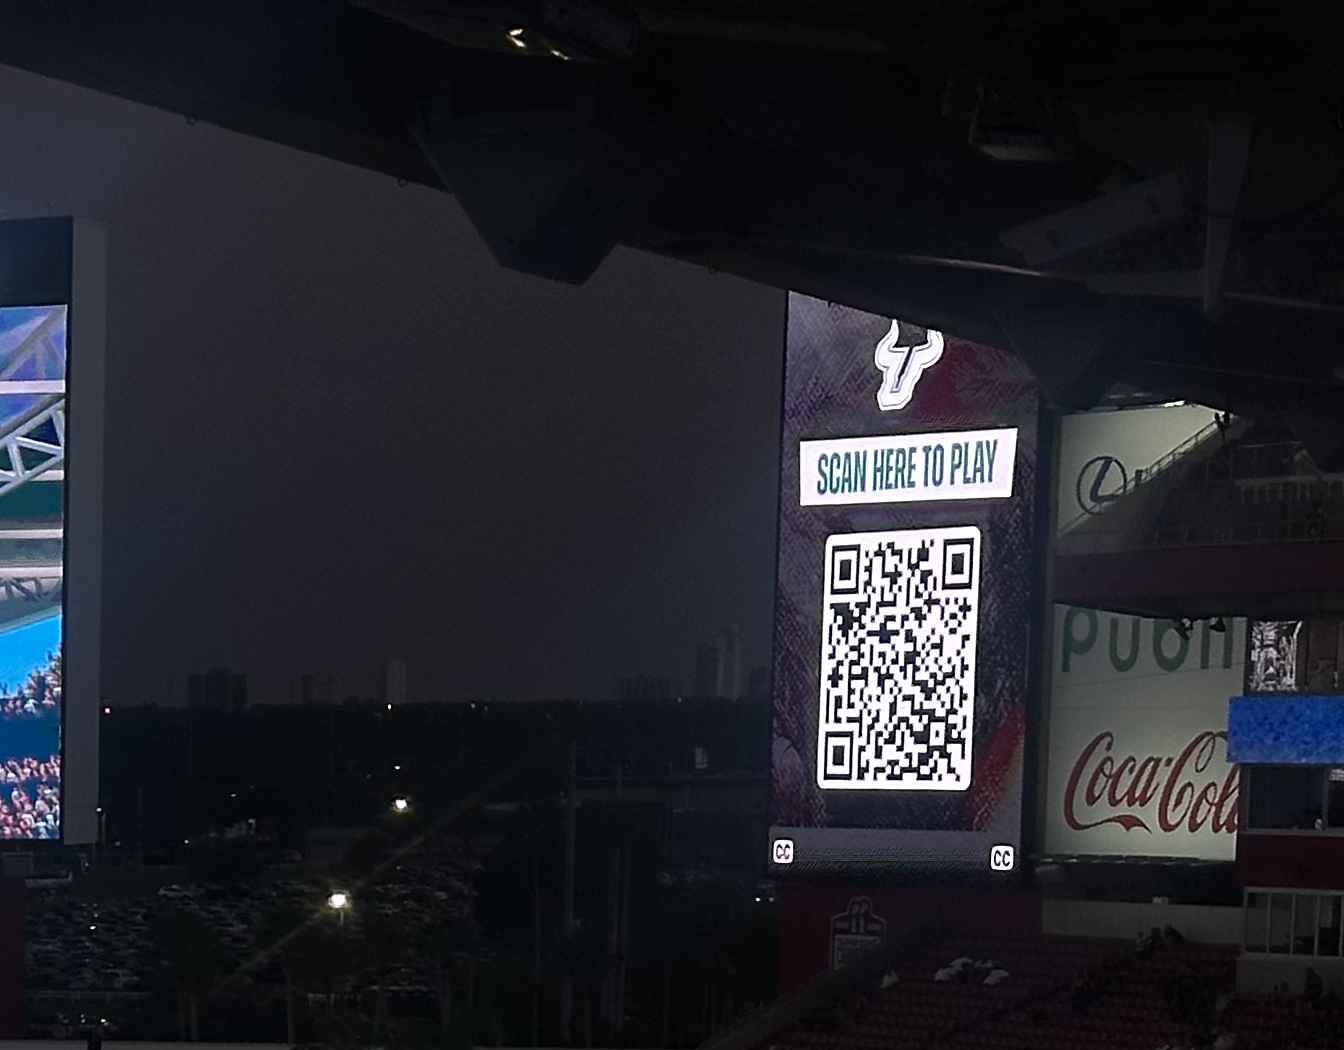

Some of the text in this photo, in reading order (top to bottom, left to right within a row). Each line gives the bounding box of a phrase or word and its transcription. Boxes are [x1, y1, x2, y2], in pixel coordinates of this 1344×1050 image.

[817, 439, 999, 496] SCAN HERE TO PLAY
[993, 850, 1011, 867] CC
